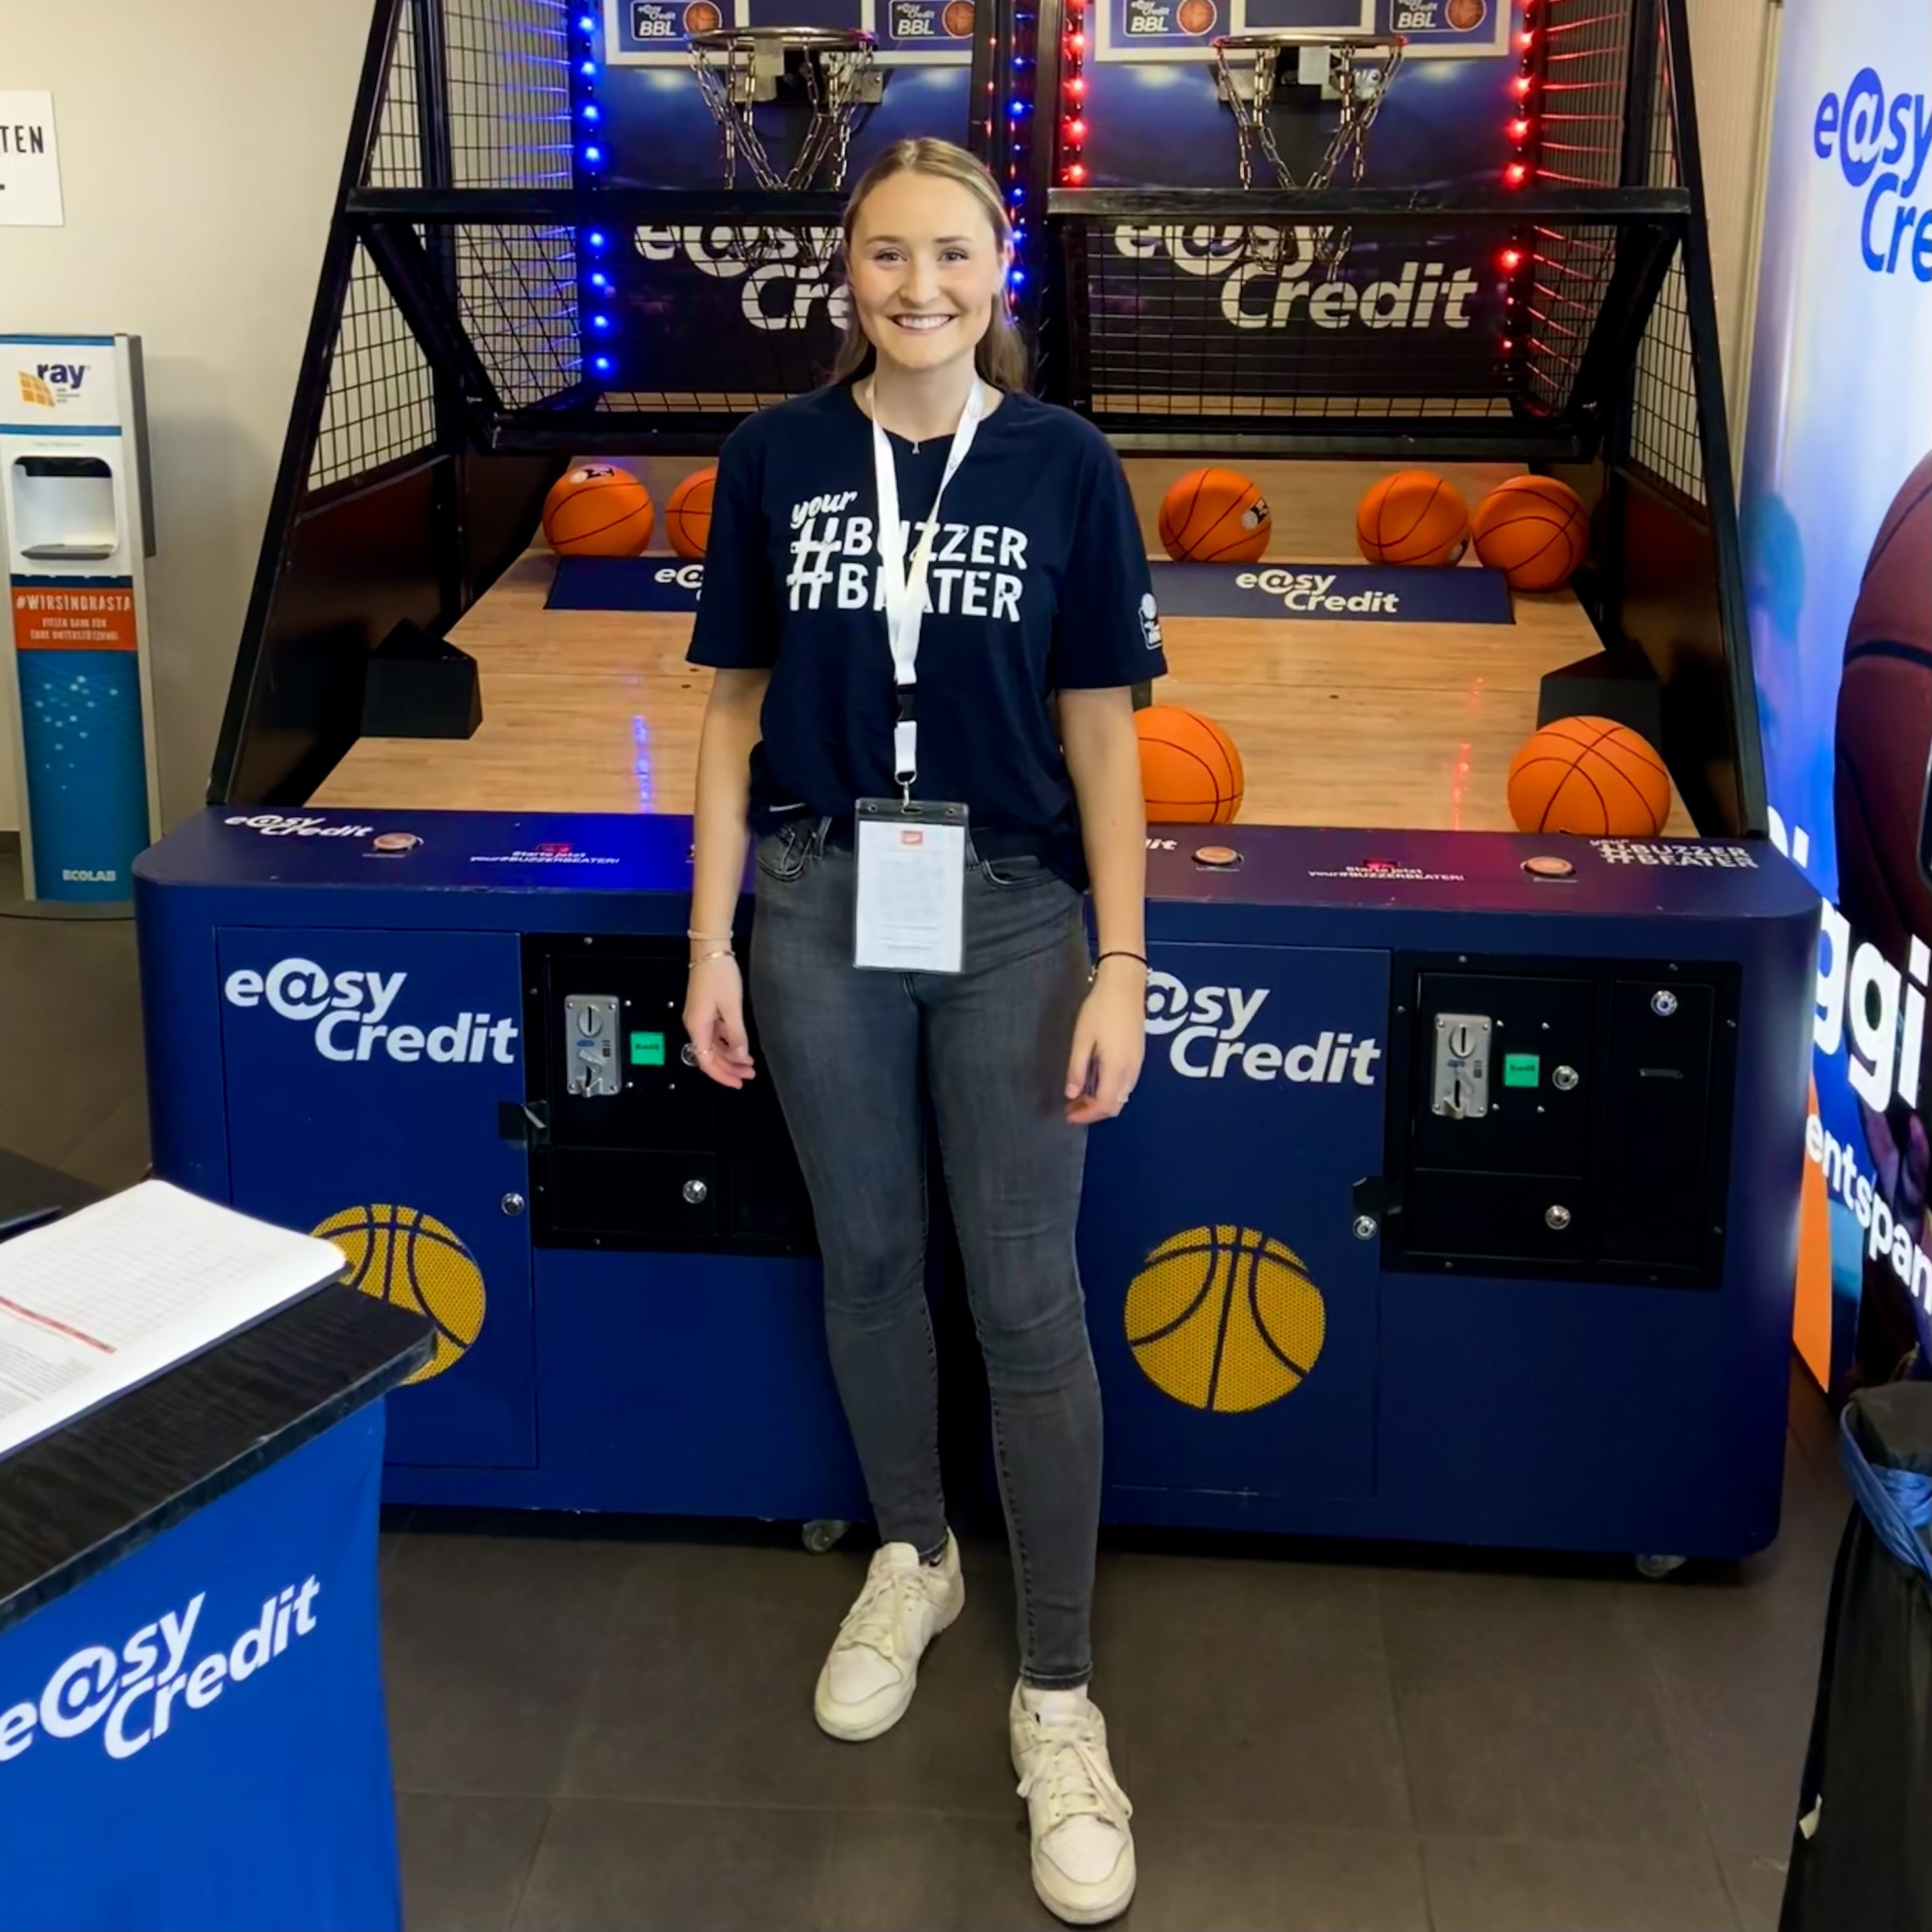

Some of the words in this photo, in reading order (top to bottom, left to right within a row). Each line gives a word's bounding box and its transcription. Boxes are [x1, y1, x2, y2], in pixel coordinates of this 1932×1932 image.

[639, 20, 676, 36] BBL
[897, 19, 935, 35] BBL
[1130, 16, 1169, 32] BBL
[1398, 12, 1436, 28] BBL
[1221, 262, 1478, 329] Credit
[37, 364, 86, 389] ray
[790, 491, 858, 529] your
[1284, 590, 1399, 613] Credit
[63, 869, 117, 882] ECOLAB
[315, 1010, 518, 1064] Credit
[1170, 1026, 1381, 1086] Credit
[105, 1574, 320, 1759] Credit
